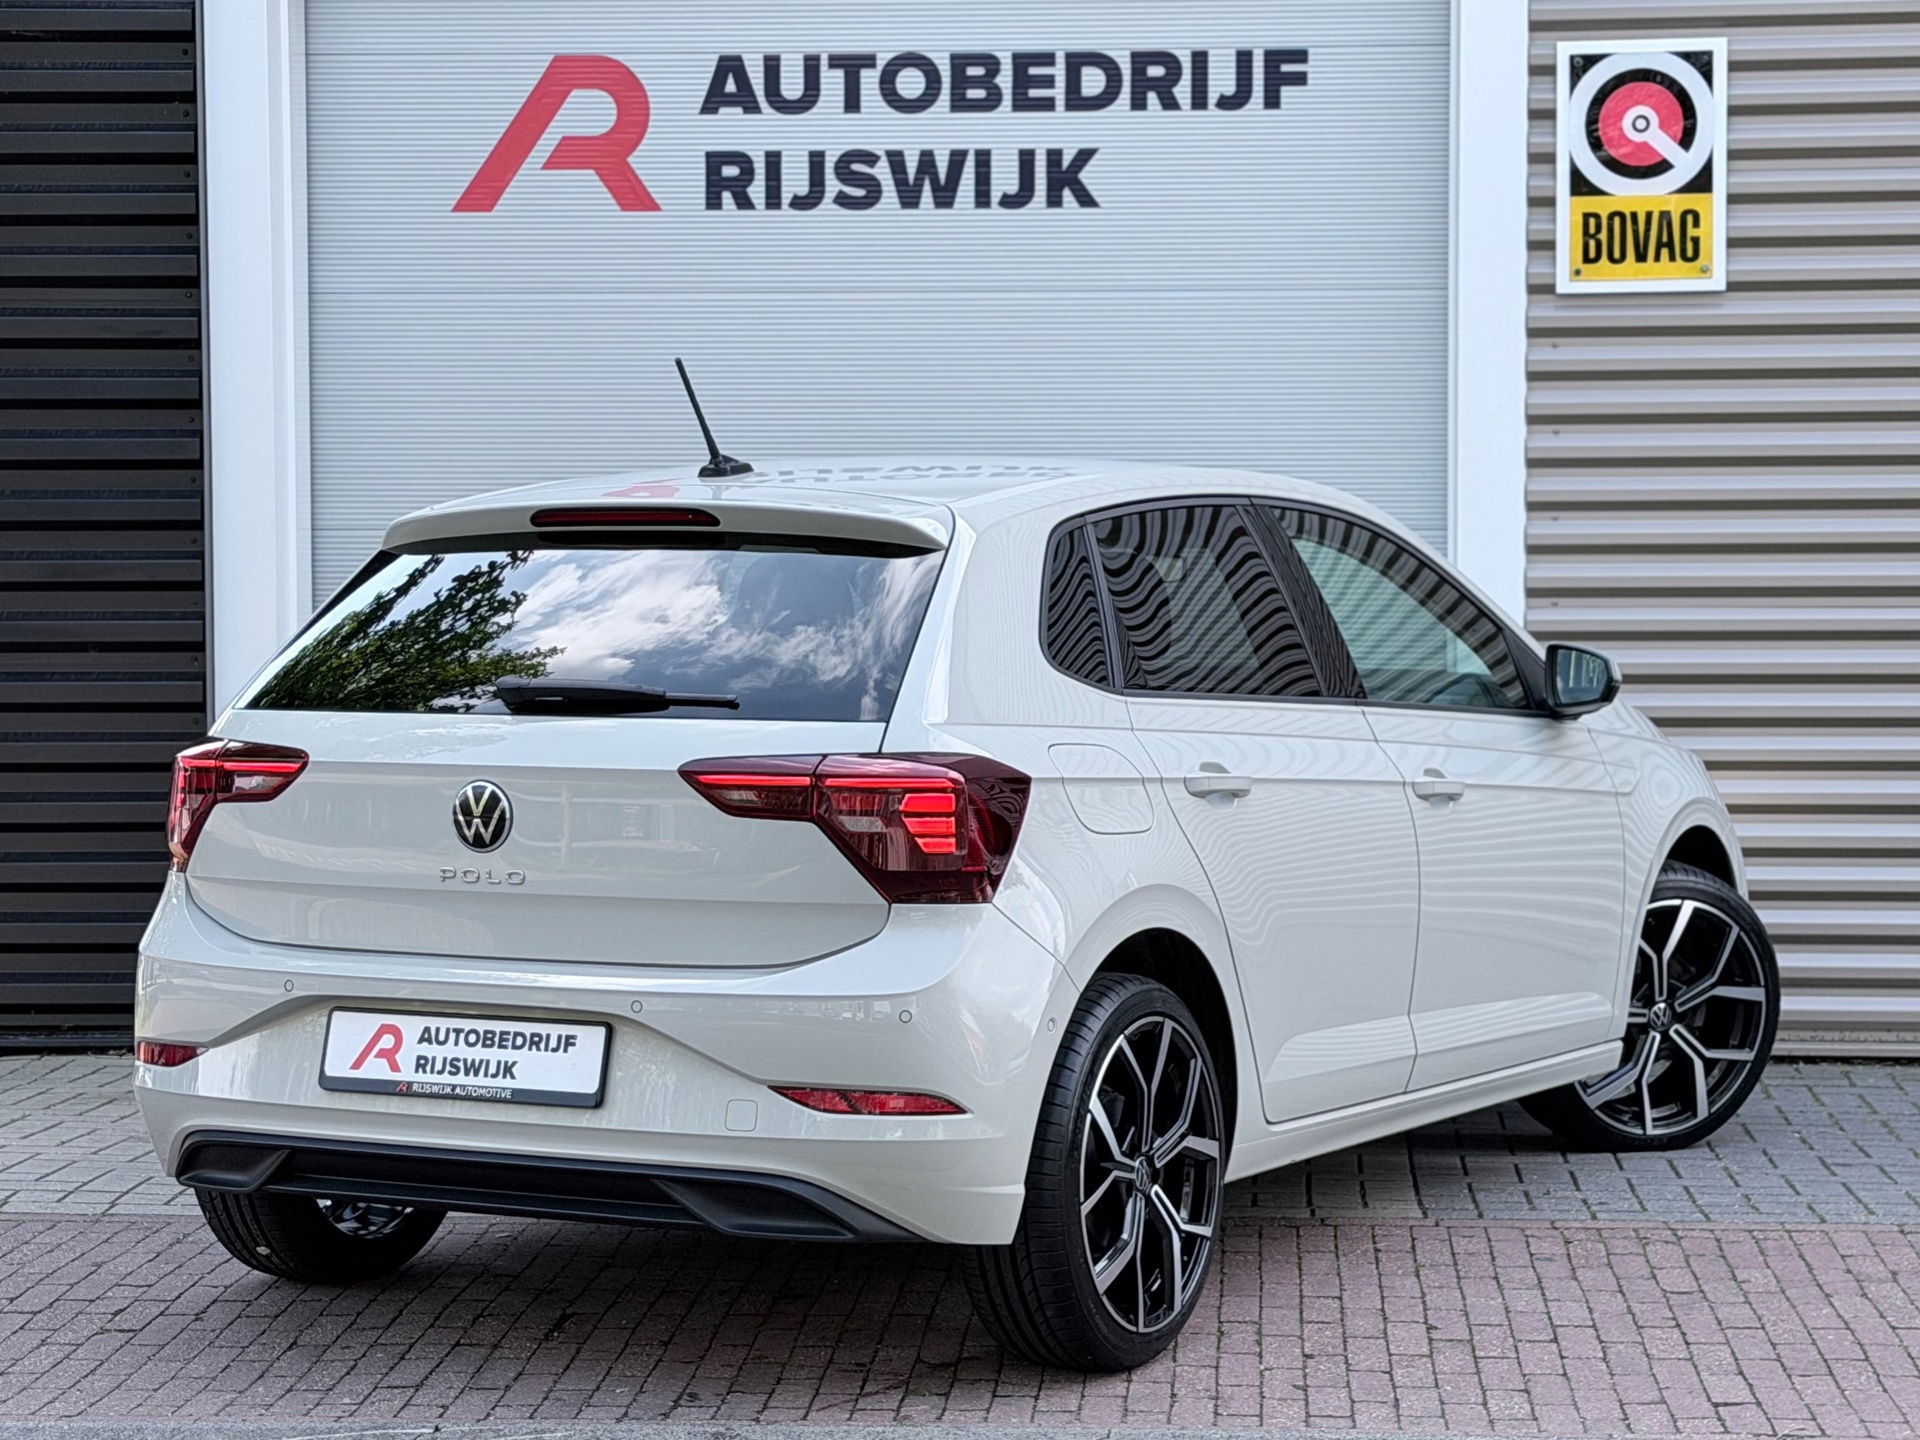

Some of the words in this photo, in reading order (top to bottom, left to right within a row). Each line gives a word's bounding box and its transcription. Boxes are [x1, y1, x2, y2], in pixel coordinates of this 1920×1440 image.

[699, 49, 1310, 116] AUTOBEDRIJF
[704, 148, 1101, 212] RIJSWIJK
[1581, 209, 1701, 264] BOVAG
[439, 867, 526, 885] POLO
[417, 1026, 578, 1054] AUTOBEDRIJF
[414, 1055, 519, 1080] RIJSWIJK
[412, 1083, 453, 1095] RIJSWIJK
[454, 1086, 513, 1099] AUTOMOTIVE
